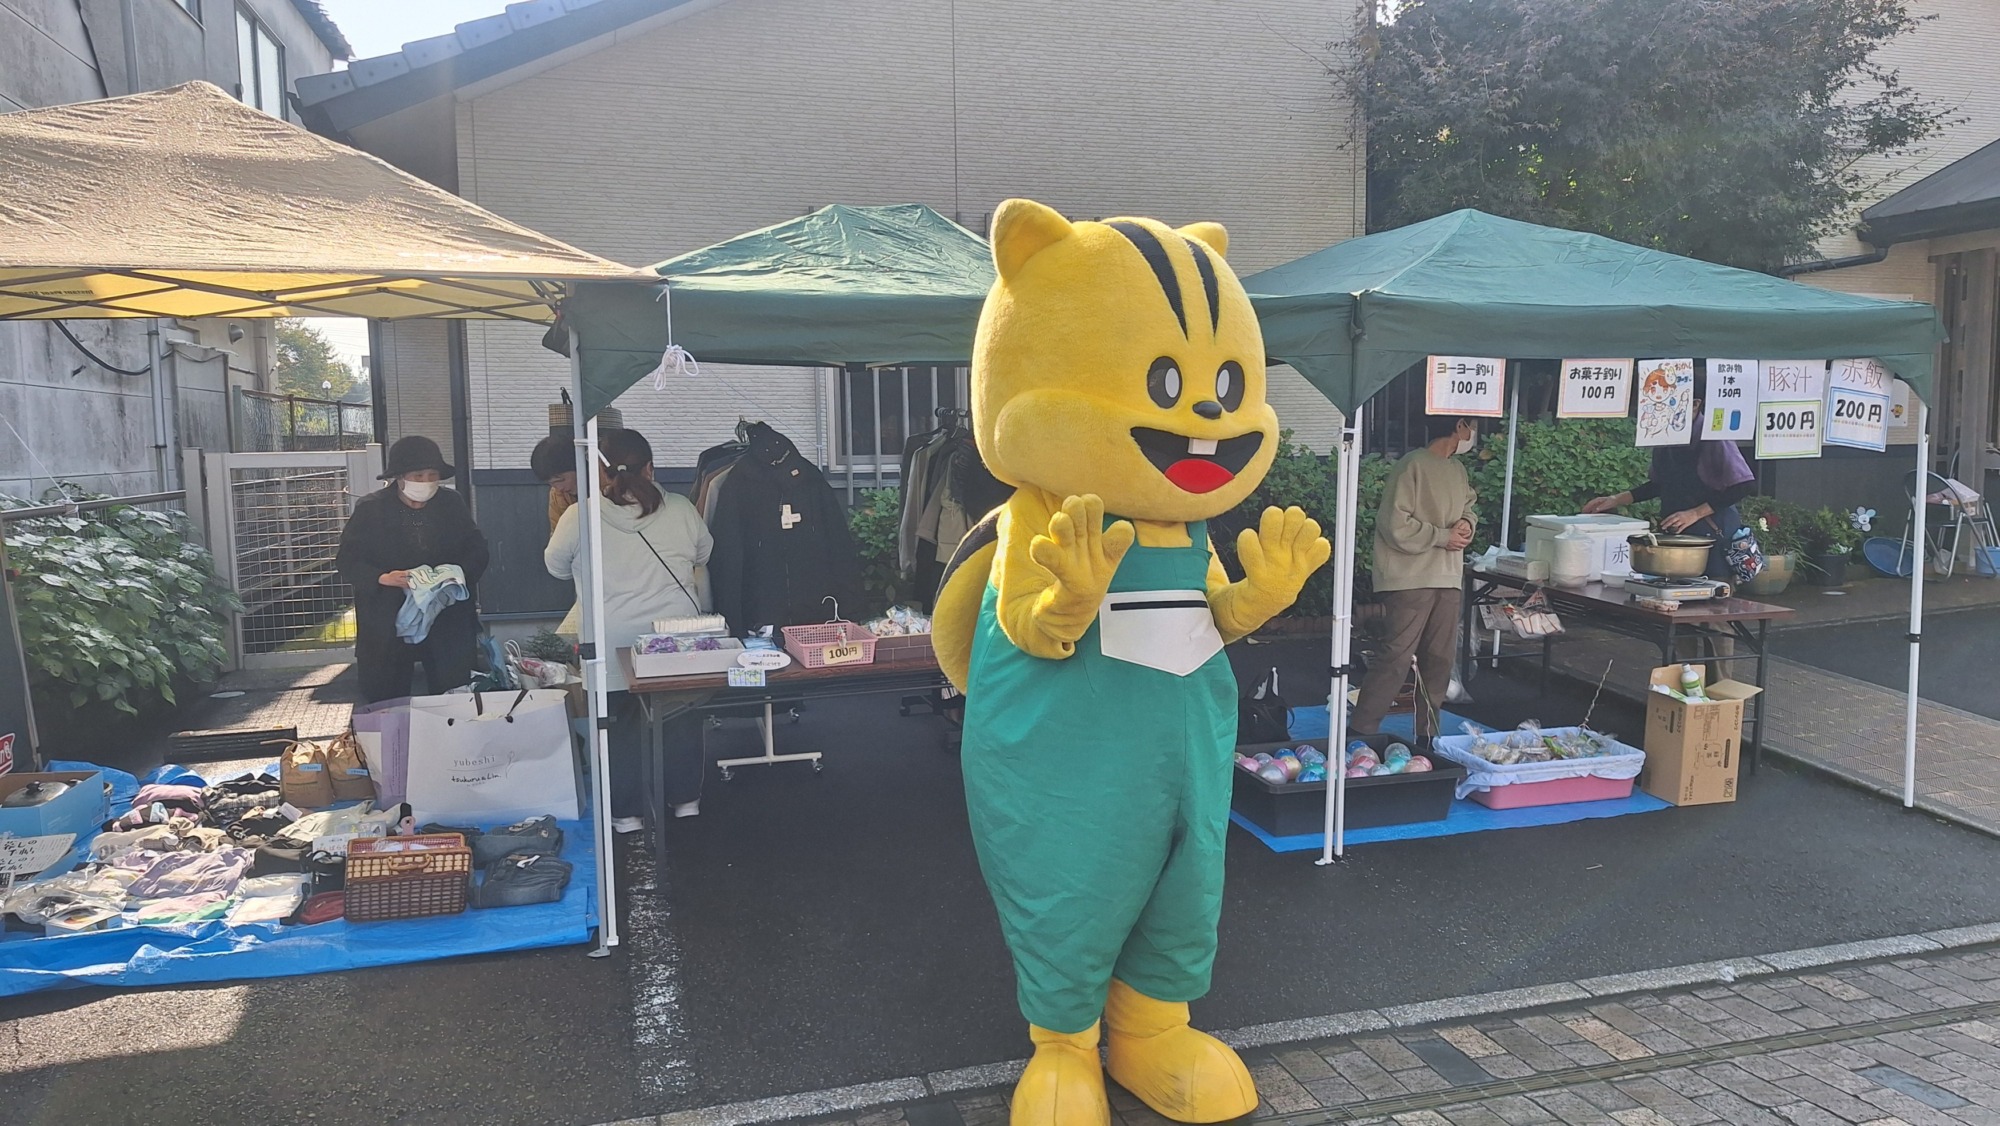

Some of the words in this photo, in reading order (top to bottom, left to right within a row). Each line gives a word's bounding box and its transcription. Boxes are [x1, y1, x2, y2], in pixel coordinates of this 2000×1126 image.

[1436, 362, 1494, 377] ヨーヨー釣り
[1569, 366, 1622, 380] お菓子釣り
[1718, 363, 1742, 373] 飲み物
[1841, 359, 1885, 389] 赤飯
[1723, 376, 1736, 386] 1本
[1768, 365, 1813, 393] 豚汁
[1450, 381, 1472, 394] 100
[1475, 382, 1487, 395] 円
[1580, 386, 1602, 399] 100
[1604, 386, 1615, 399] 円
[1718, 388, 1741, 398] 150円
[1835, 399, 1865, 420] 200
[1868, 404, 1882, 423] 円
[1766, 411, 1796, 431] 300
[1800, 410, 1815, 430] 円
[828, 646, 858, 660] 100円
[453, 755, 495, 767] yubeshi
